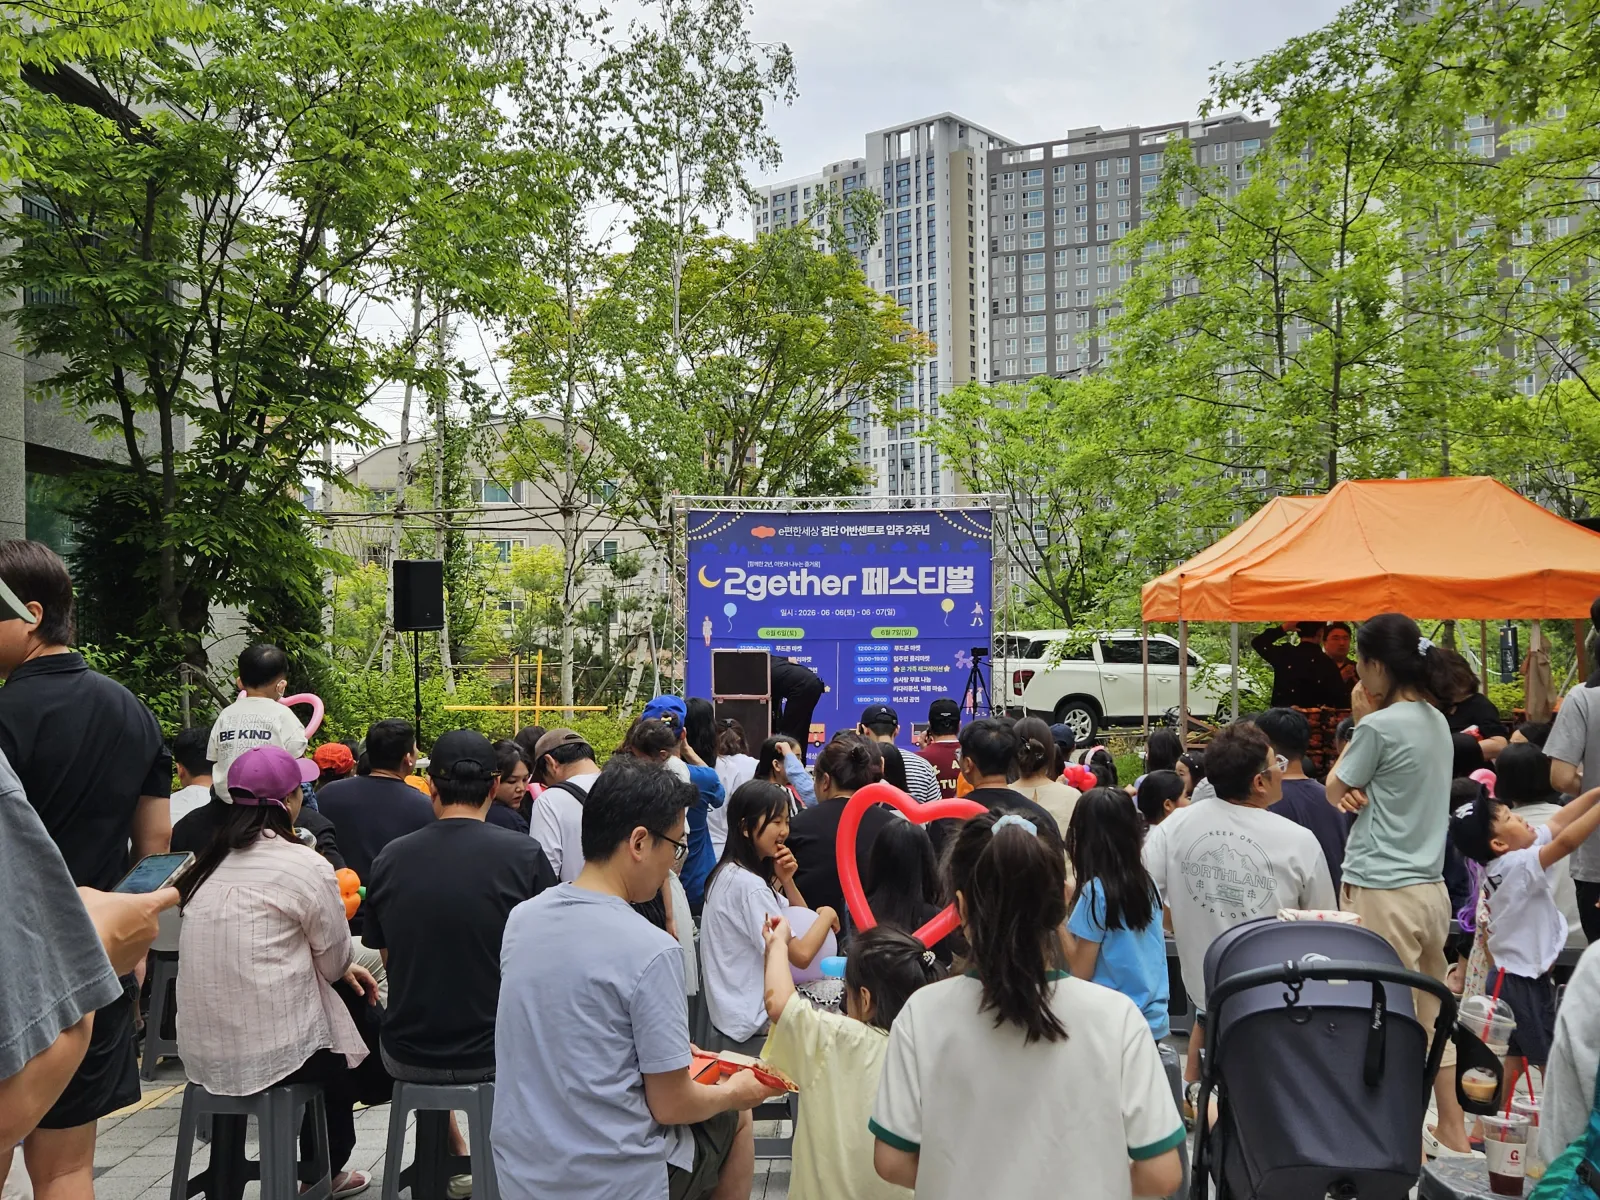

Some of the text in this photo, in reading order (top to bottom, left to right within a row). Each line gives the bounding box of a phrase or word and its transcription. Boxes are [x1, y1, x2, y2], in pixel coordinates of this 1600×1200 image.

[778, 524, 930, 537] e편한세상 검단 어반센트로 입주 2주년
[724, 566, 974, 601] 2gether 페스티벌
[780, 609, 794, 617] 일시
[798, 609, 816, 617] 2026
[834, 609, 856, 617] 06(토)
[875, 608, 896, 617] 07(일)
[777, 629, 798, 637] 6일(토)
[891, 629, 912, 637] 7일(일)
[894, 644, 909, 652] 푸드존
[909, 644, 921, 652] 마켓
[906, 665, 917, 673] 가족
[893, 676, 909, 684] 솜사탕
[892, 685, 920, 693] 키다리풍선,
[931, 685, 948, 693] 마술쇼
[220, 730, 272, 742] BE KIND
[1239, 834, 1253, 845] ON
[1180, 861, 1278, 891] NORTHLAND
[1192, 895, 1258, 919] EXPLORE
[1510, 1149, 1519, 1161] G
